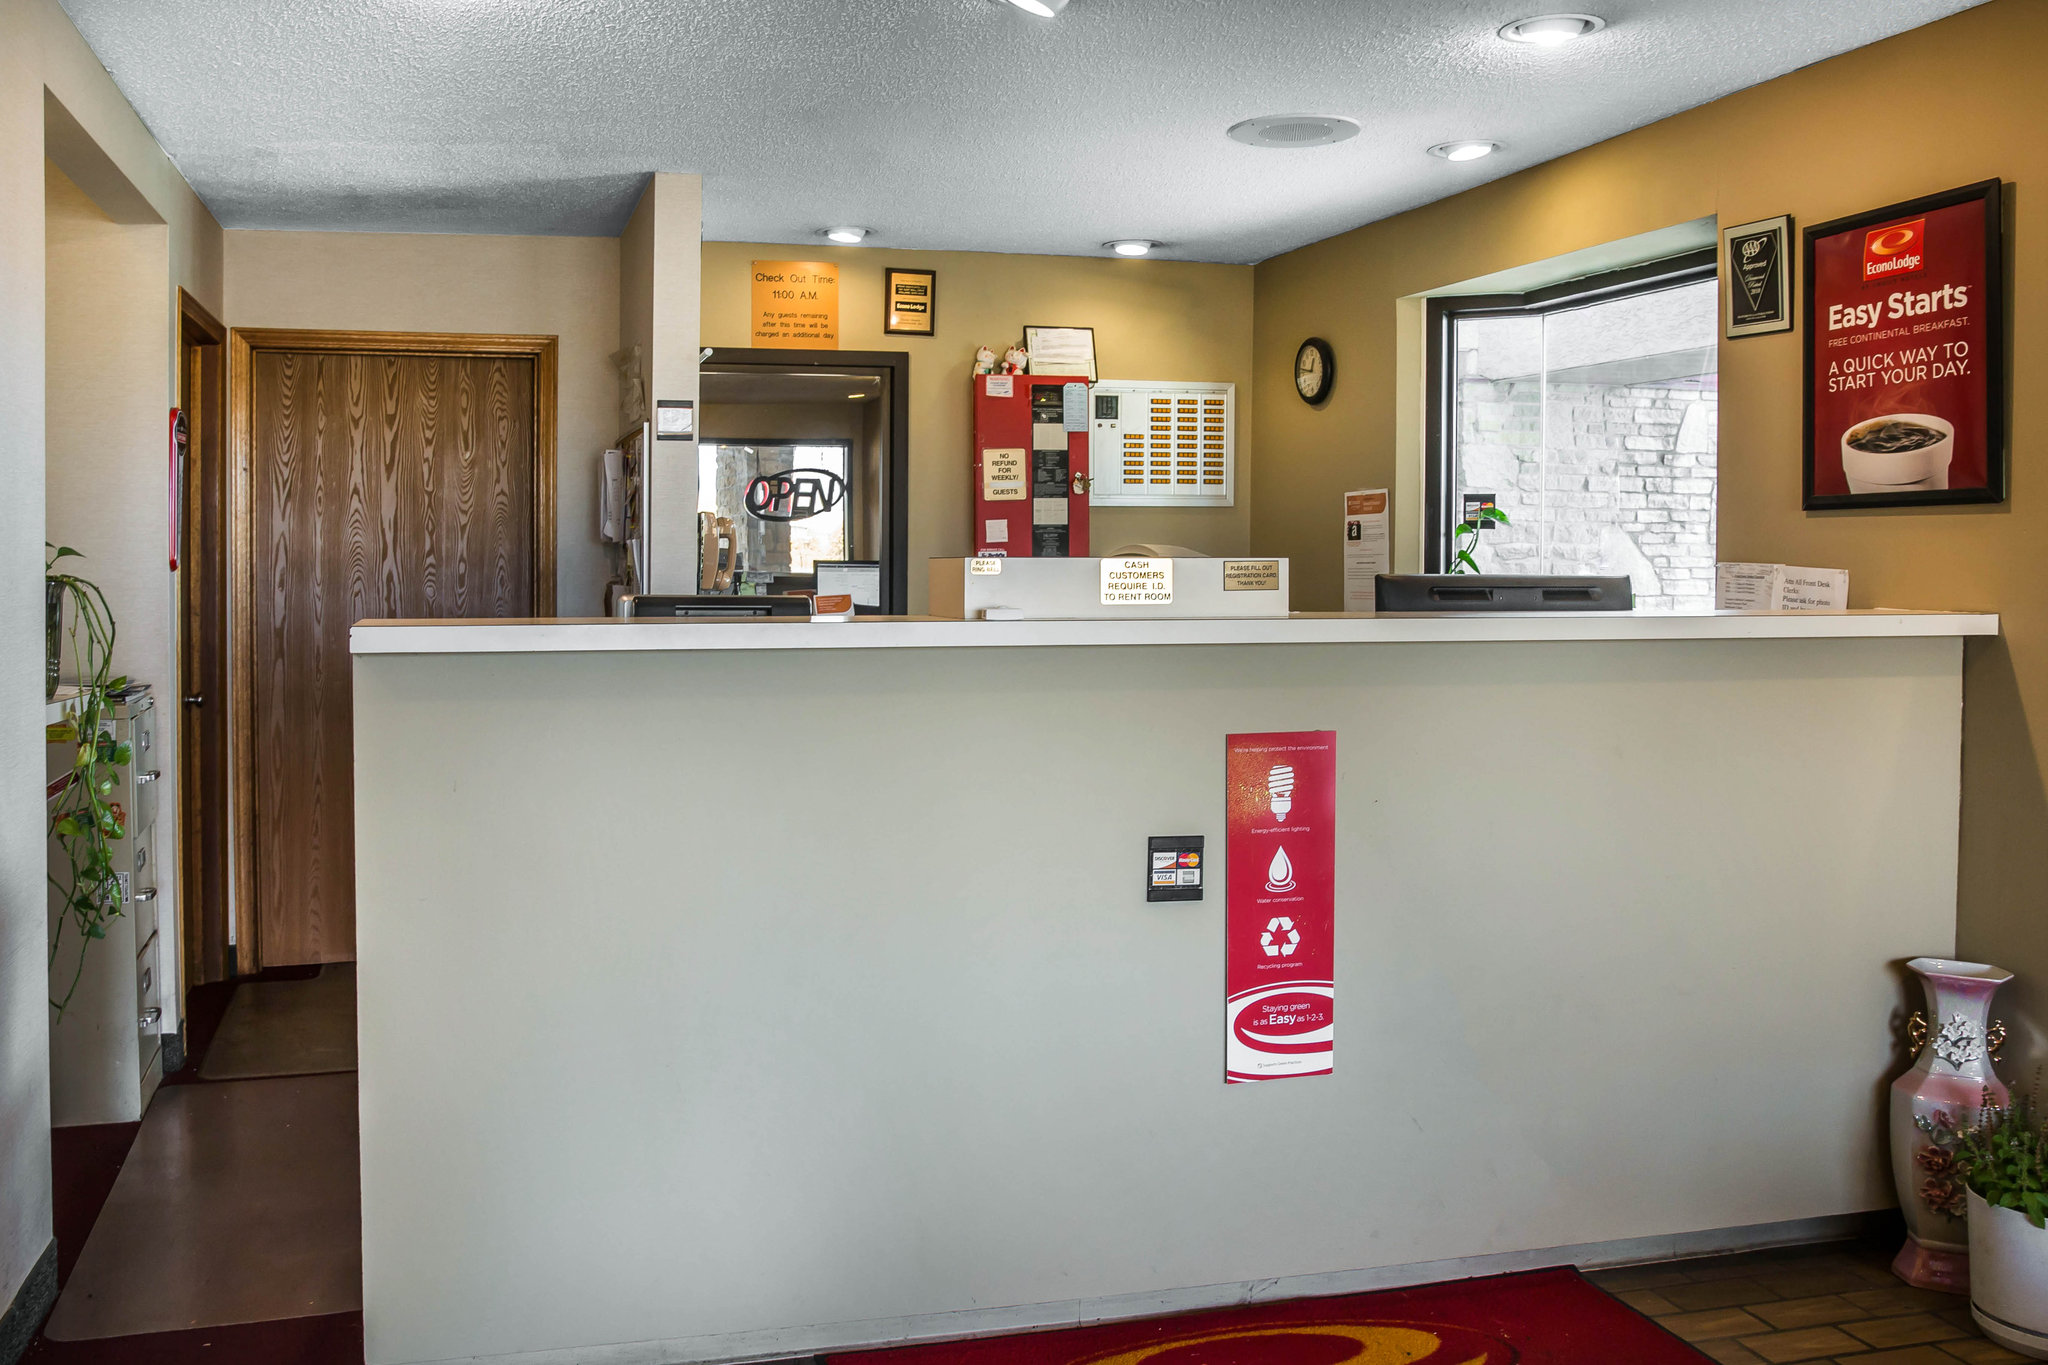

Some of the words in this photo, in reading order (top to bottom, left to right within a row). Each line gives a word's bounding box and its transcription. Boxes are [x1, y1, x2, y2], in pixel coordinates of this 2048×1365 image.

[1866, 254, 1920, 276] EconoLodge
[755, 272, 785, 283] Check
[790, 274, 806, 283] Out
[772, 290, 795, 299] 11:00
[799, 291, 819, 300] A.M.
[762, 311, 775, 319] Any
[778, 312, 798, 320] guests
[1828, 301, 1883, 331] Easy
[823, 332, 835, 340] day
[1828, 337, 1849, 348] FREE
[1850, 327, 1910, 345] CONTINENTAL
[1913, 316, 1971, 334] BREAKFAST.
[1828, 361, 1840, 376] A
[1843, 352, 1895, 374] QUICK
[1899, 345, 1938, 366] WAY
[1943, 341, 1969, 359] TO
[1828, 372, 1876, 392] START
[1881, 365, 1927, 385] YOUR
[1933, 359, 1971, 379] DAY.
[745, 476, 837, 513] OPEN
[1124, 561, 1150, 569] CASH
[1109, 572, 1165, 580] CUSTOMERS
[1108, 582, 1147, 590] REQUIRE
[1152, 582, 1166, 590] I.D.
[1802, 579, 1816, 587] Front
[1817, 580, 1831, 588] Desk
[1104, 593, 1116, 601] TO
[1118, 593, 1142, 601] RENT
[1144, 593, 1171, 601] ROOM
[1782, 596, 1799, 604] Please
[1291, 825, 1310, 833] lighting
[1281, 961, 1303, 969] program
[1262, 1004, 1289, 1013] Staying
[1290, 1003, 1310, 1012] green
[1269, 1014, 1297, 1026] Easy
